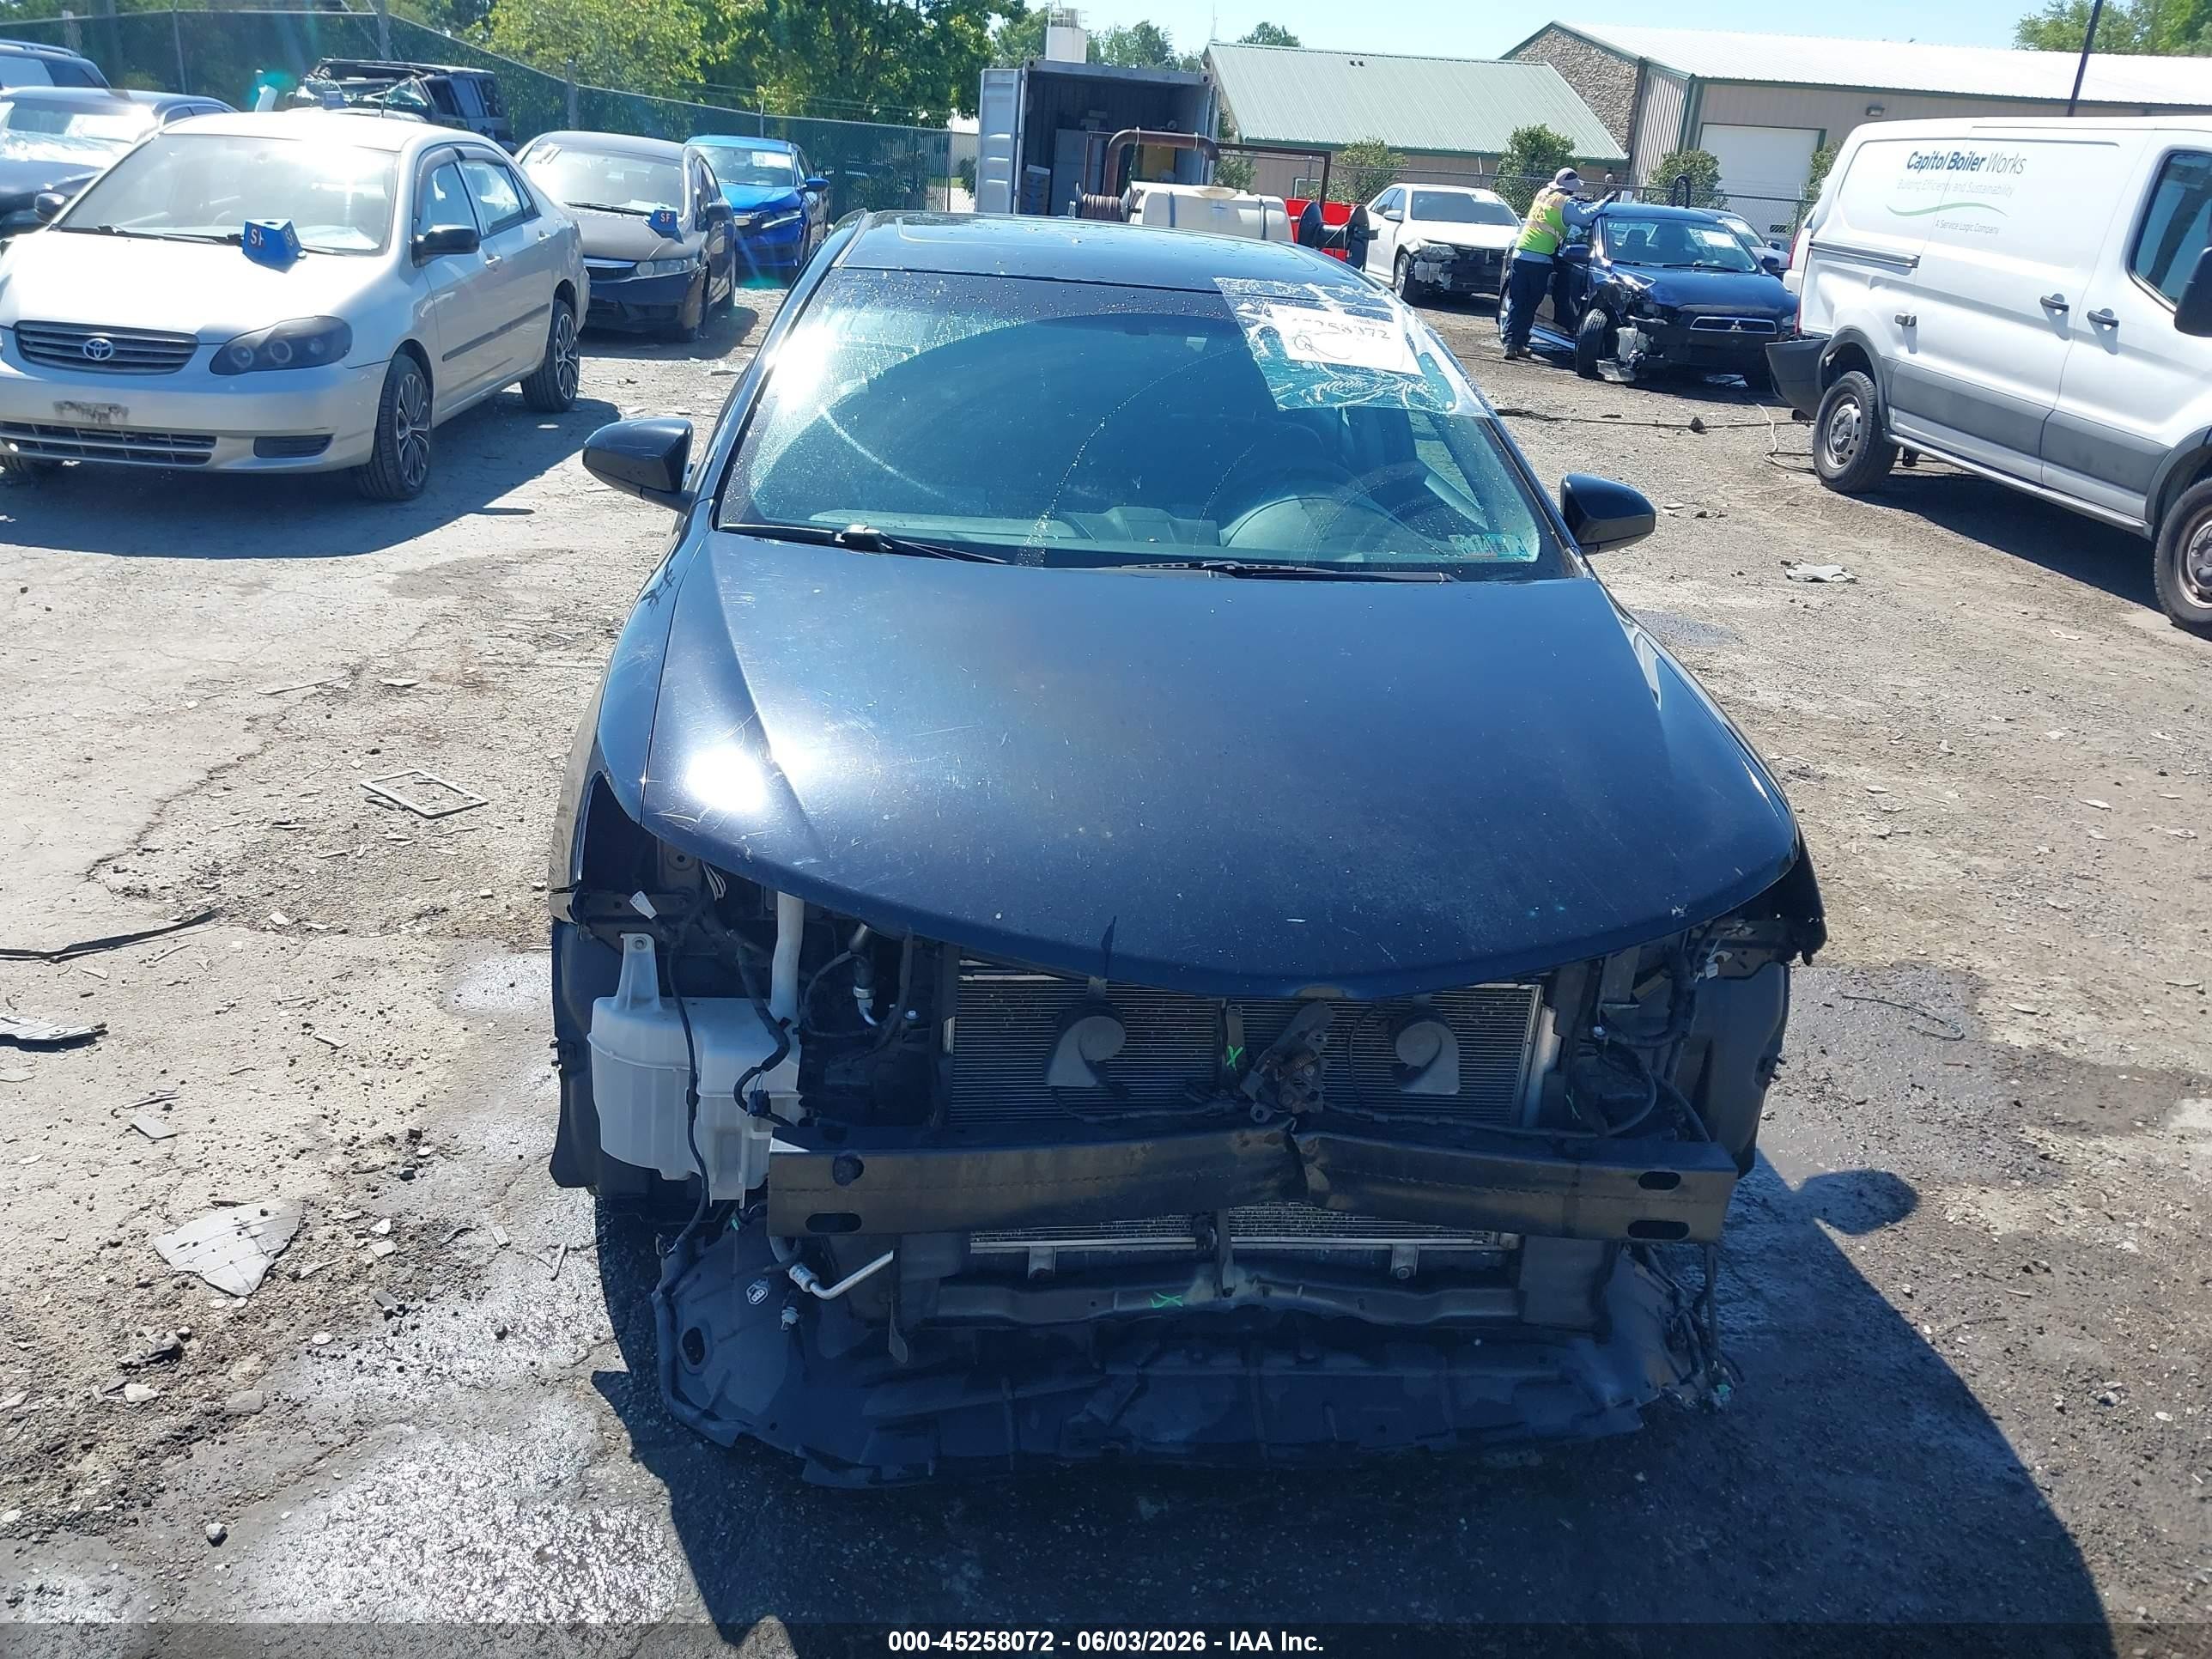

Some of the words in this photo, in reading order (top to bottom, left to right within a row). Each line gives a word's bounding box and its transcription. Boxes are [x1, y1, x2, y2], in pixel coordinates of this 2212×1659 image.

[1907, 150, 1950, 173] Capitol
[1947, 150, 1987, 172] Boiler
[1985, 152, 2027, 174] Works
[1952, 181, 1966, 192] and
[1966, 181, 2015, 198] Sustainability
[661, 213, 671, 222] SF
[1935, 219, 1940, 228] A
[1940, 219, 1959, 229] Service
[1959, 222, 1973, 233] Logic
[1973, 222, 2000, 234] Company
